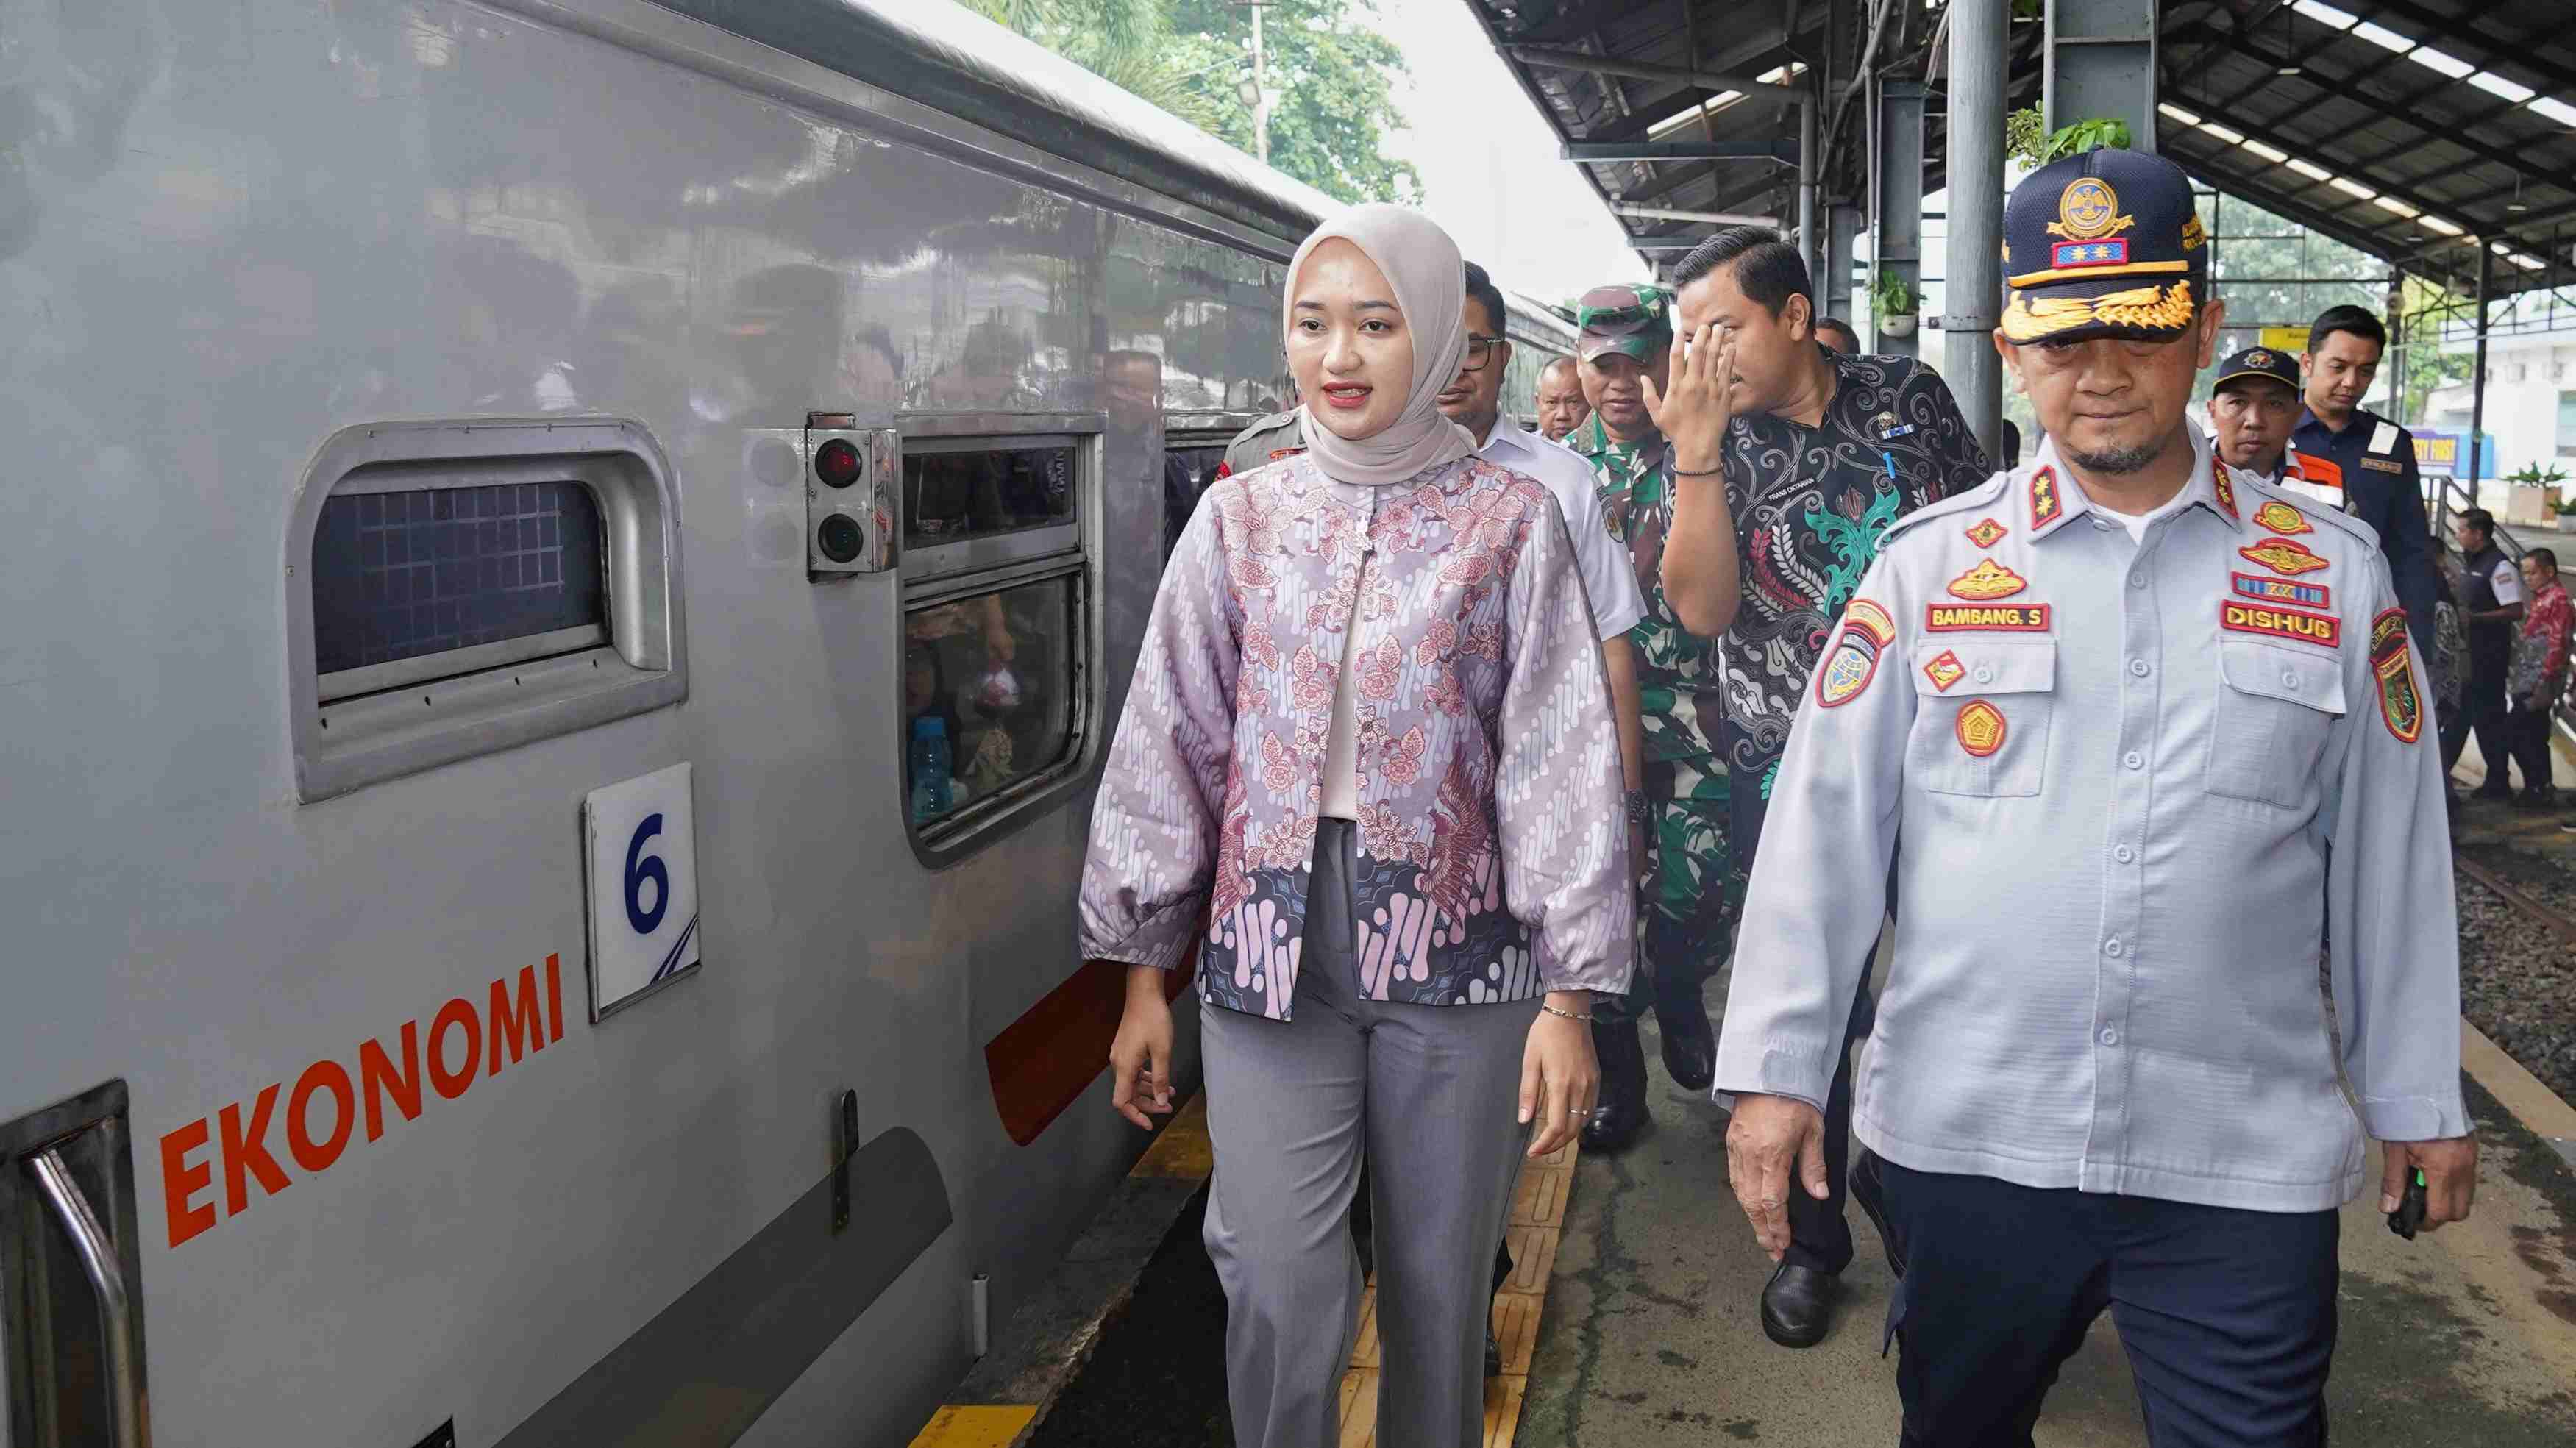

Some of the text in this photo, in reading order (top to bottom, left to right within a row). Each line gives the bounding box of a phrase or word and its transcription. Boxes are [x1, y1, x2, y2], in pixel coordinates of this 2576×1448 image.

[1768, 488, 1787, 501] FRANS
[2028, 609, 2041, 625] S
[2227, 607, 2332, 638] DISHUB
[624, 813, 669, 934] 6
[160, 953, 564, 1249] EKONOMI
